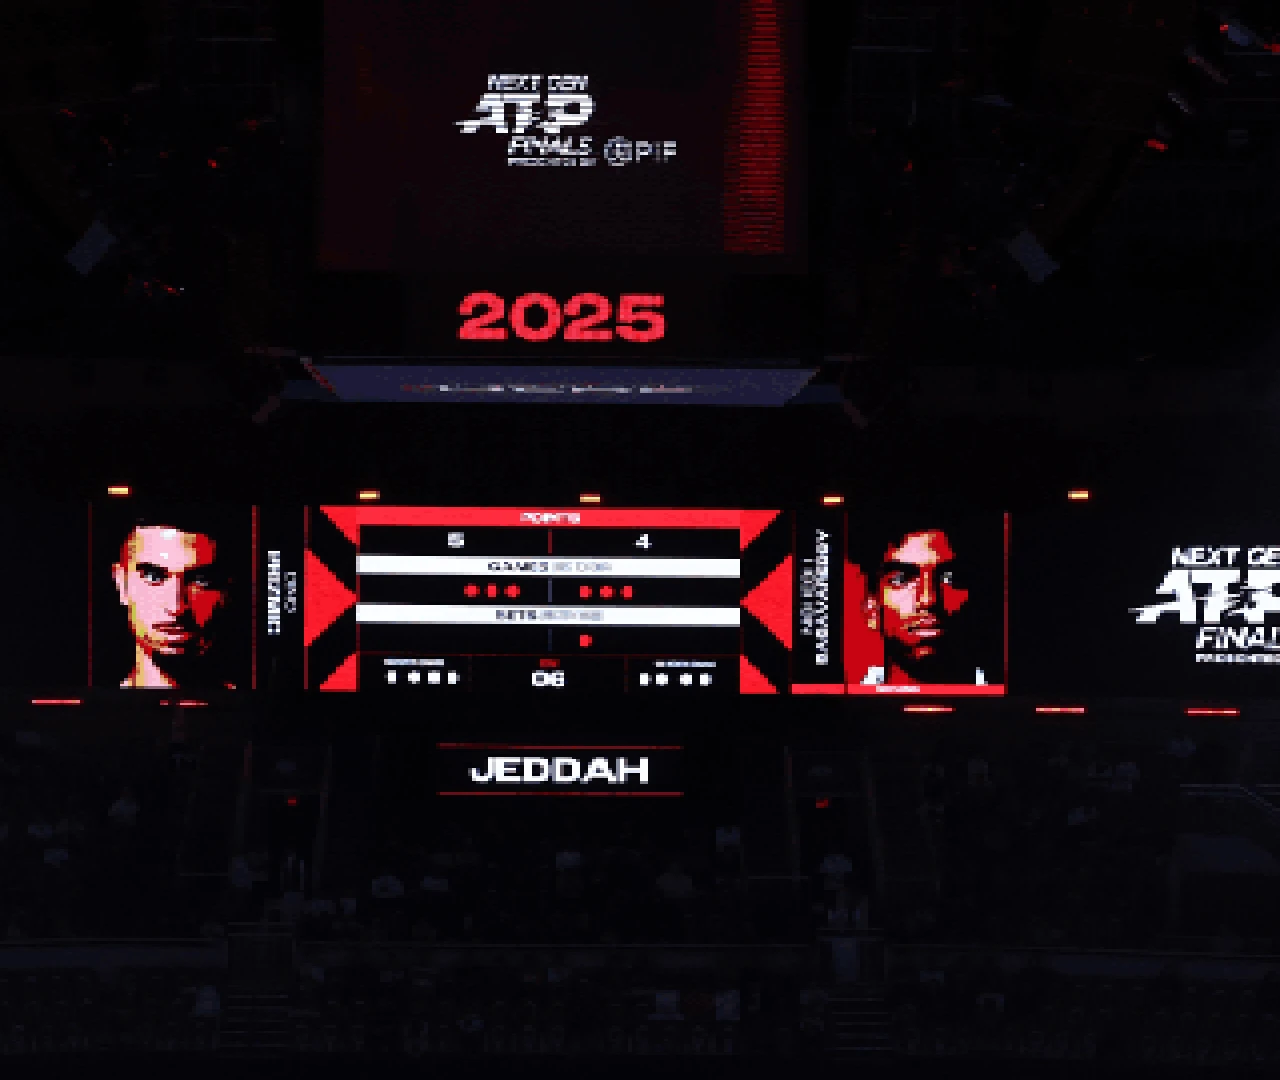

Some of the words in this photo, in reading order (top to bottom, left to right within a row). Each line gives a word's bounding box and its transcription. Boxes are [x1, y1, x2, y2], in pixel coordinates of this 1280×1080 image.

[488, 74, 540, 90] NEXT
[548, 74, 588, 90] GEN
[453, 93, 596, 134] ATP
[507, 137, 593, 156] FINALS
[635, 141, 677, 163] PIF
[456, 290, 666, 342] 2025
[633, 533, 652, 551] 4
[1171, 546, 1241, 566] NEXT
[468, 756, 648, 784] JEDDAH
